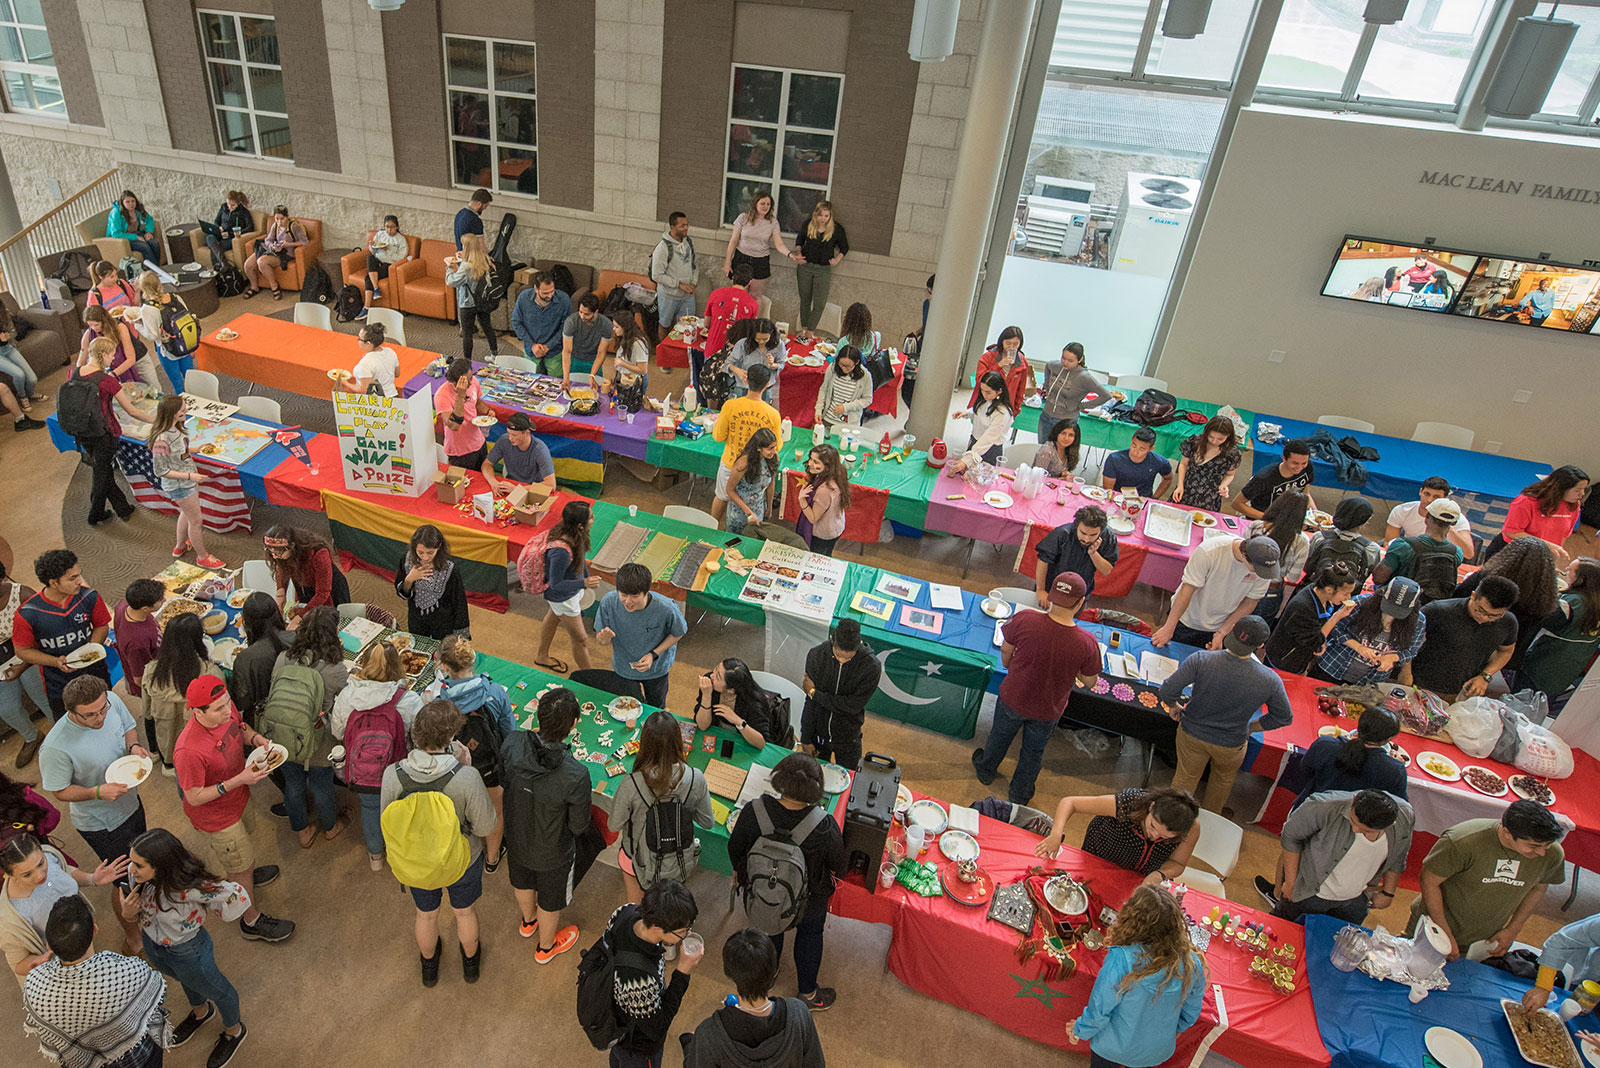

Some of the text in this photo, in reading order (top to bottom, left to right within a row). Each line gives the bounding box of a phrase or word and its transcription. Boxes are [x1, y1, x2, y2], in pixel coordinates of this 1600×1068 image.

[1154, 218, 1180, 226] DAIKIN
[335, 392, 393, 408] LEARN
[354, 417, 388, 430] PLAY
[732, 411, 771, 425] ANGELES
[365, 428, 374, 438] A
[345, 448, 389, 466] WIN
[352, 467, 414, 486] A PRIZE
[764, 546, 804, 560] PAKISTAN
[808, 556, 832, 567] INDIA
[40, 627, 92, 649] NEPAL
[1240, 632, 1248, 640] U
